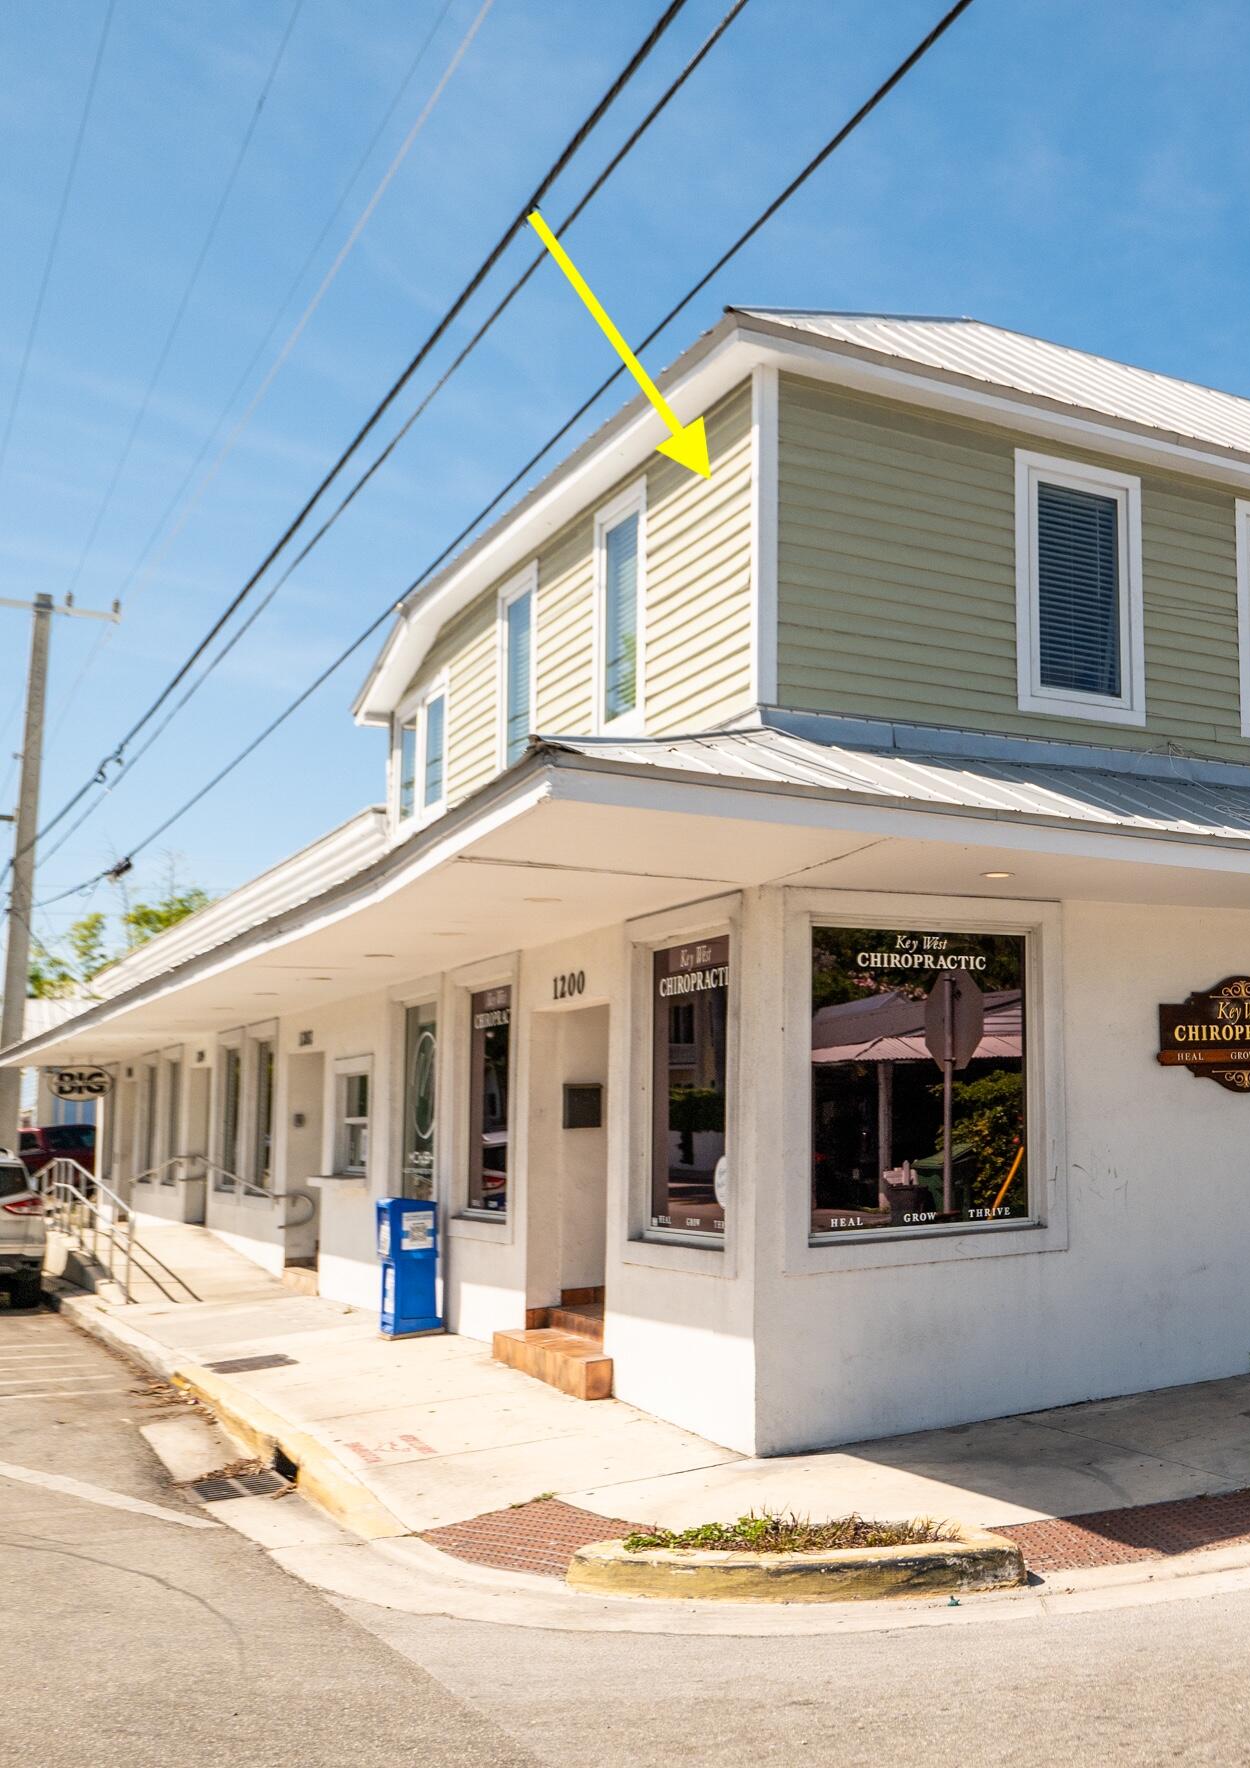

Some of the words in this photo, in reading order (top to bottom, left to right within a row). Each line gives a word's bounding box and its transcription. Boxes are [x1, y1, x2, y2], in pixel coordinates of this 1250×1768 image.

[894, 934, 919, 953] Key
[922, 936, 949, 950] West
[857, 952, 987, 970] CHIROPRACTIC
[552, 970, 586, 1001] 1200
[1216, 1001, 1243, 1026] Key
[1176, 1052, 1205, 1061] HEAL
[58, 1071, 105, 1095] BIG
[830, 1216, 864, 1228] HEAL
[902, 1211, 938, 1223] GROW
[967, 1206, 1012, 1218] THRIVE
